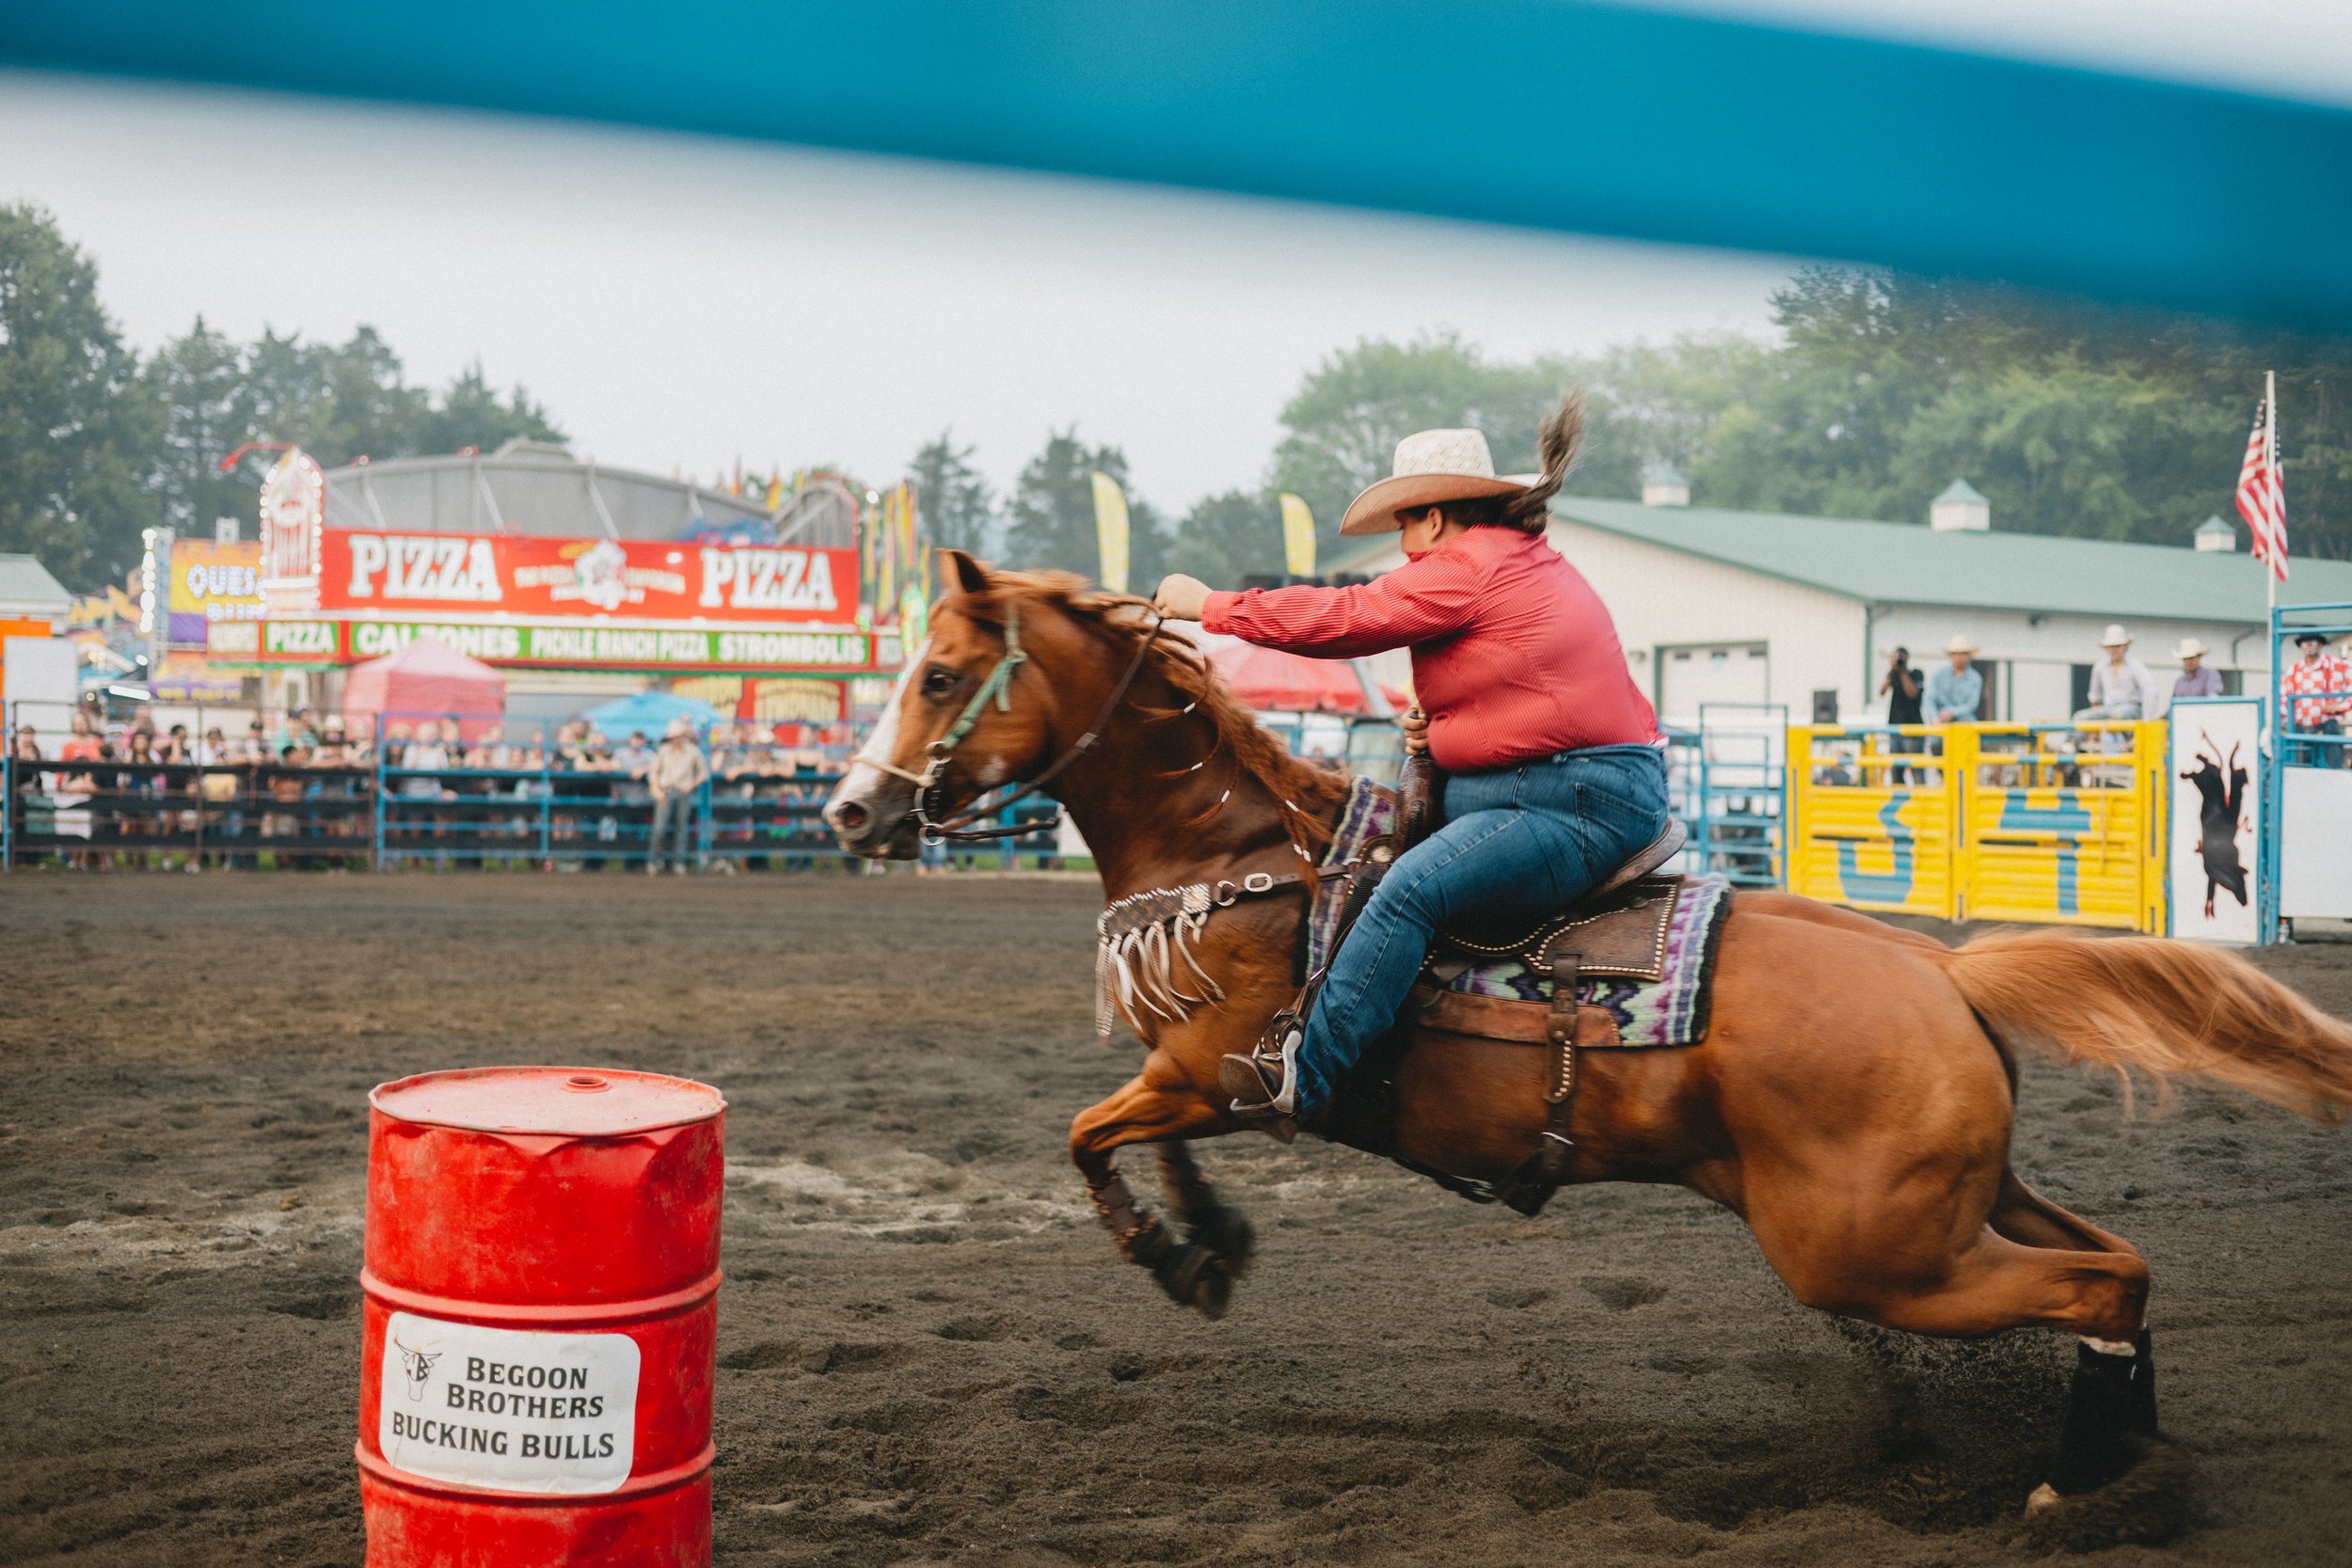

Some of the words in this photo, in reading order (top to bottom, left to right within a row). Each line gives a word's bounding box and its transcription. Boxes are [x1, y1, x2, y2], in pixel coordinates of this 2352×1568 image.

[187, 563, 265, 598] QUES
[347, 533, 502, 601] PIZZA
[699, 547, 837, 610] PIZZA
[266, 622, 336, 654] PIZZA
[660, 633, 709, 661] PIZZA
[718, 633, 866, 665] STROMBOLIS
[467, 1356, 588, 1389] BEGOON
[447, 1383, 604, 1418] BROTHERS
[392, 1411, 508, 1456] BUCKING
[520, 1433, 613, 1459] BULLS
